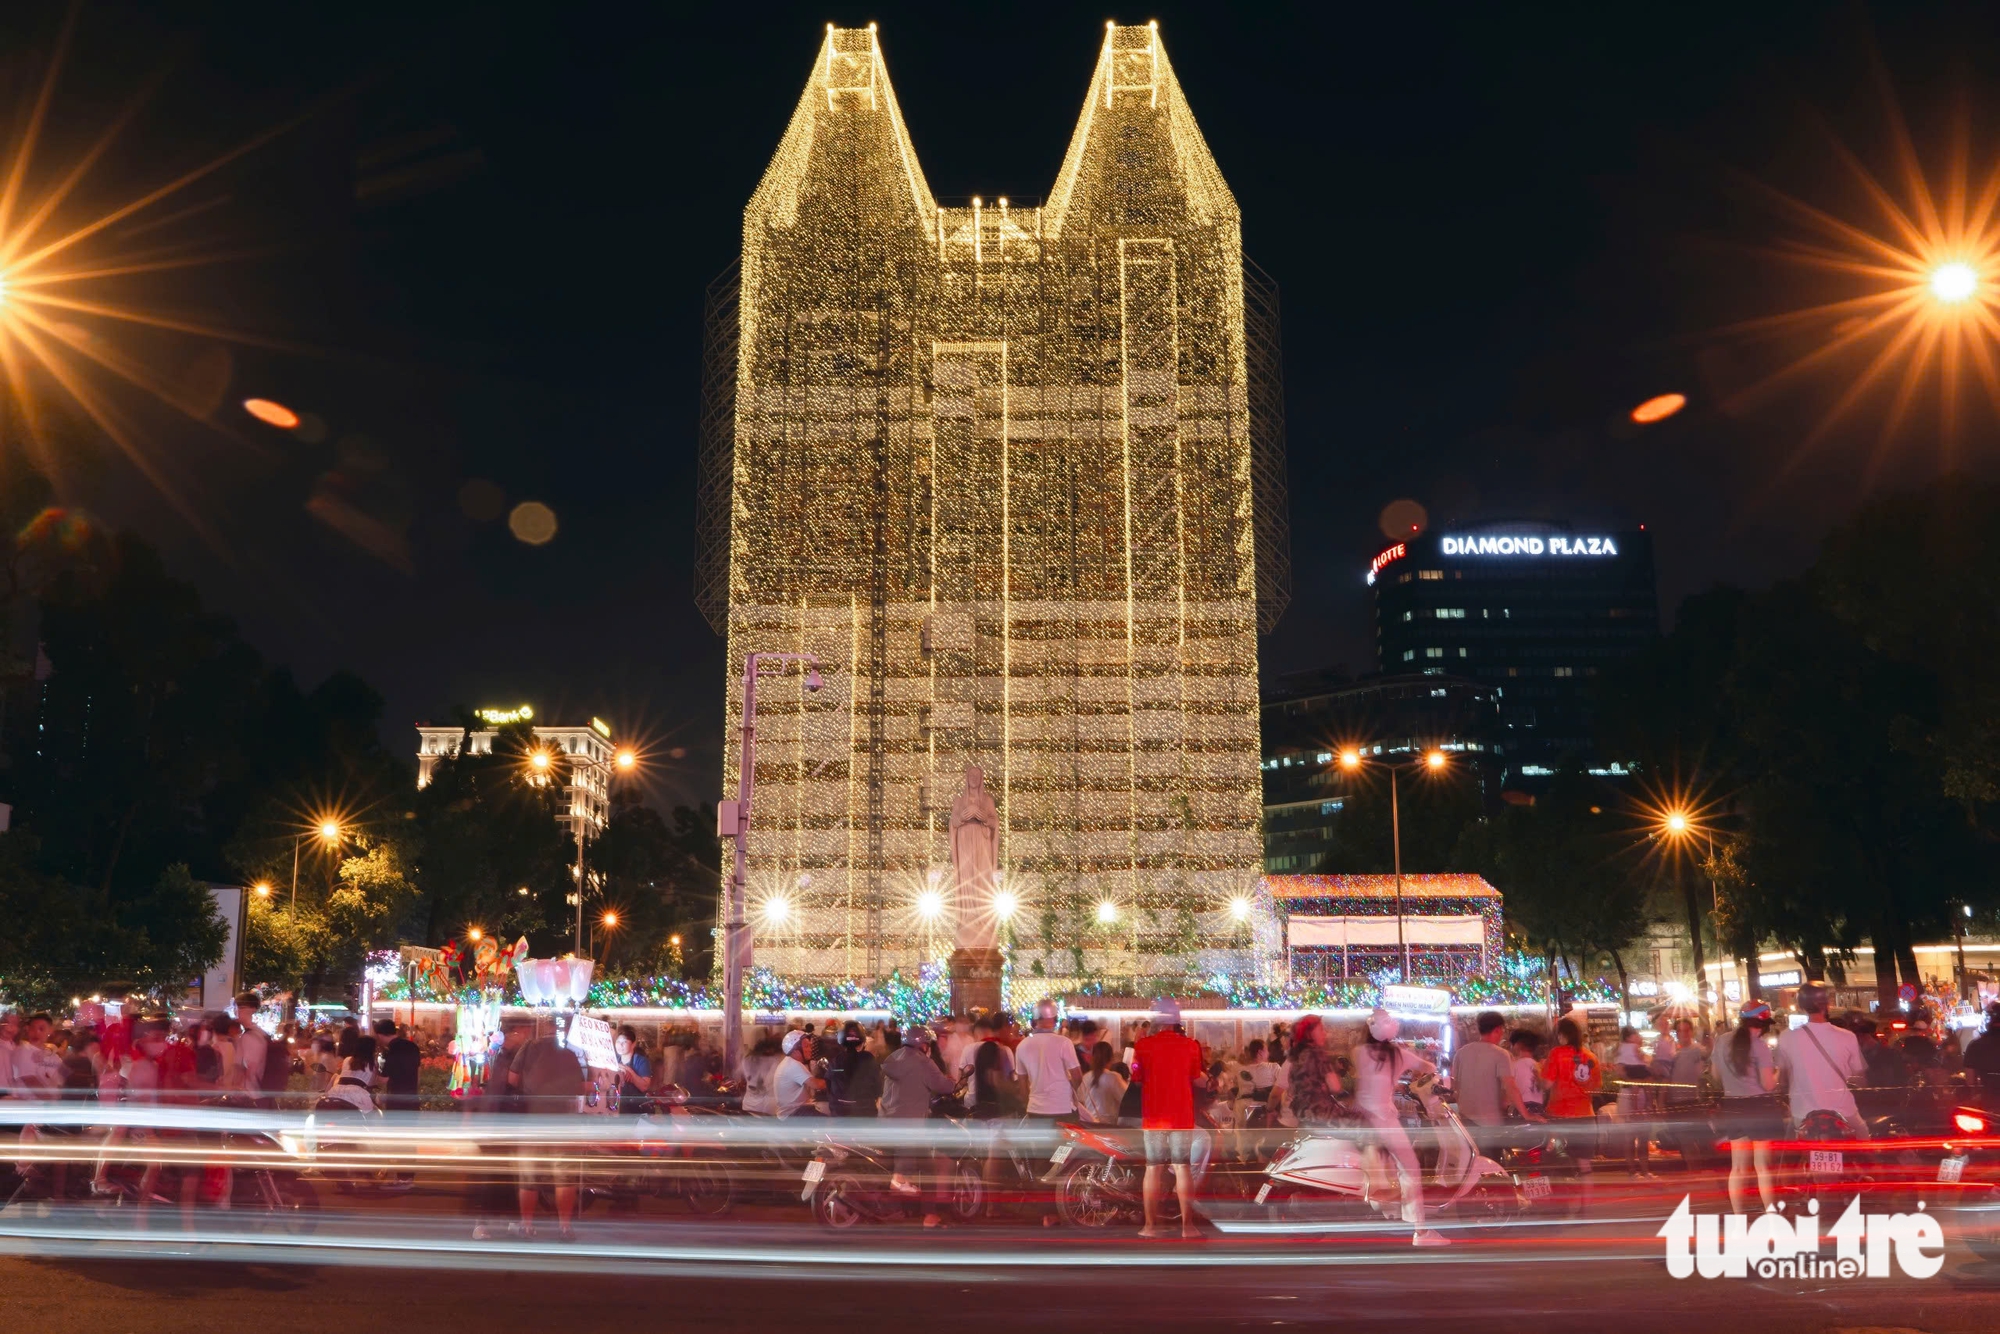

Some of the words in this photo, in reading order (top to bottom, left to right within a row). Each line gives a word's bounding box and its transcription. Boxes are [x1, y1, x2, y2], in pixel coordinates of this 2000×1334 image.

[1442, 536, 1544, 555] DIAMOND
[1549, 537, 1618, 555] PLAZA
[1377, 543, 1406, 568] LOTTE
[1814, 1152, 1838, 1162] 59-B1
